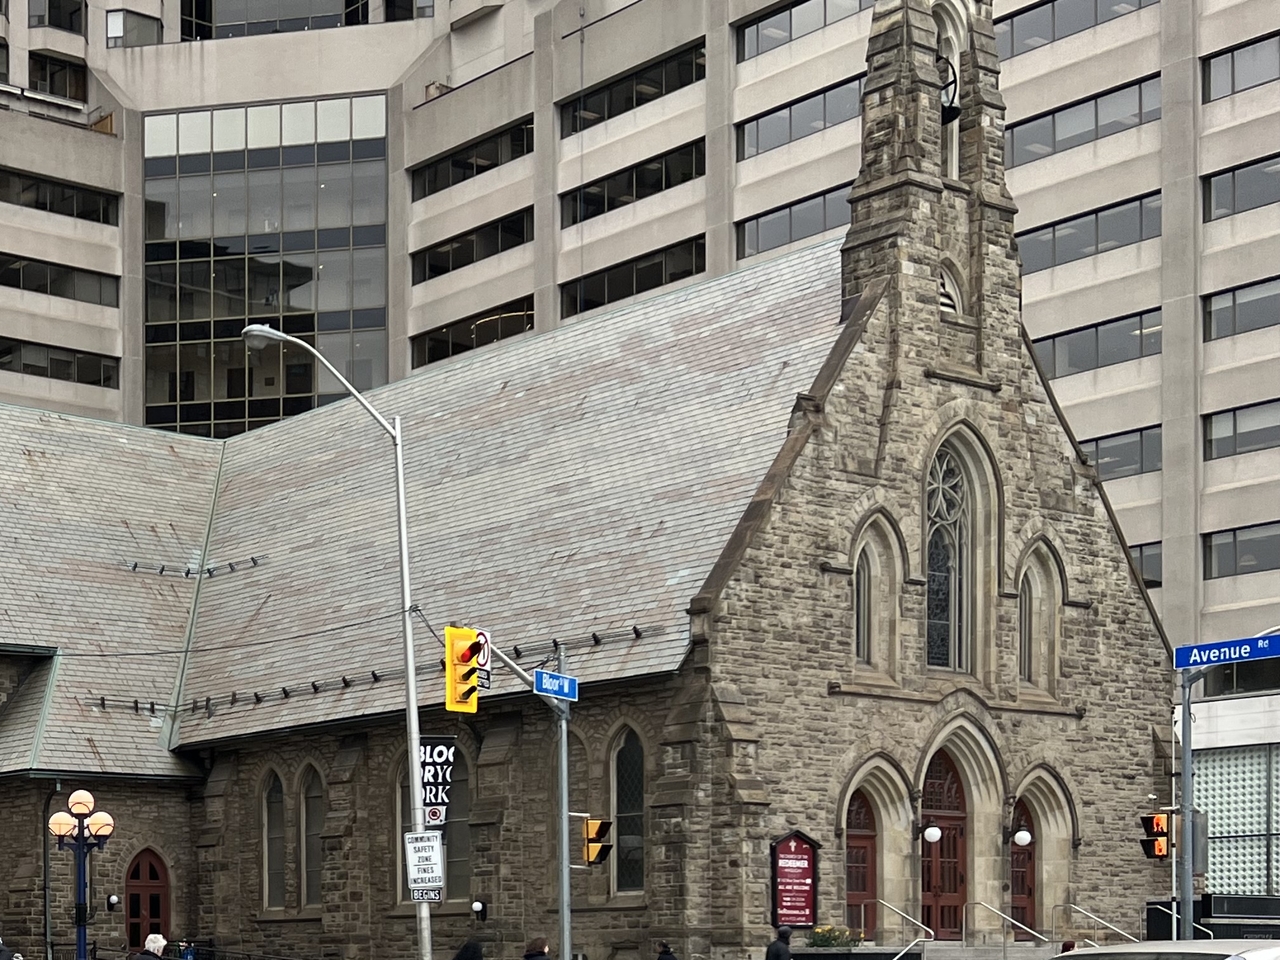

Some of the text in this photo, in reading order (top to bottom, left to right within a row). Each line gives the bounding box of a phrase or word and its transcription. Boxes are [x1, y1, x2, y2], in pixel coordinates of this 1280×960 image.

[1189, 639, 1269, 664] Avenue Rd
[542, 673, 560, 691] Bloor
[422, 785, 451, 803] RK
[407, 835, 438, 844] COMMUNITY
[413, 845, 434, 853] SAFETY
[417, 855, 432, 863] ZONE
[417, 866, 434, 874] FINES
[410, 875, 442, 885] INCREASED
[413, 890, 440, 900] BEGINS
